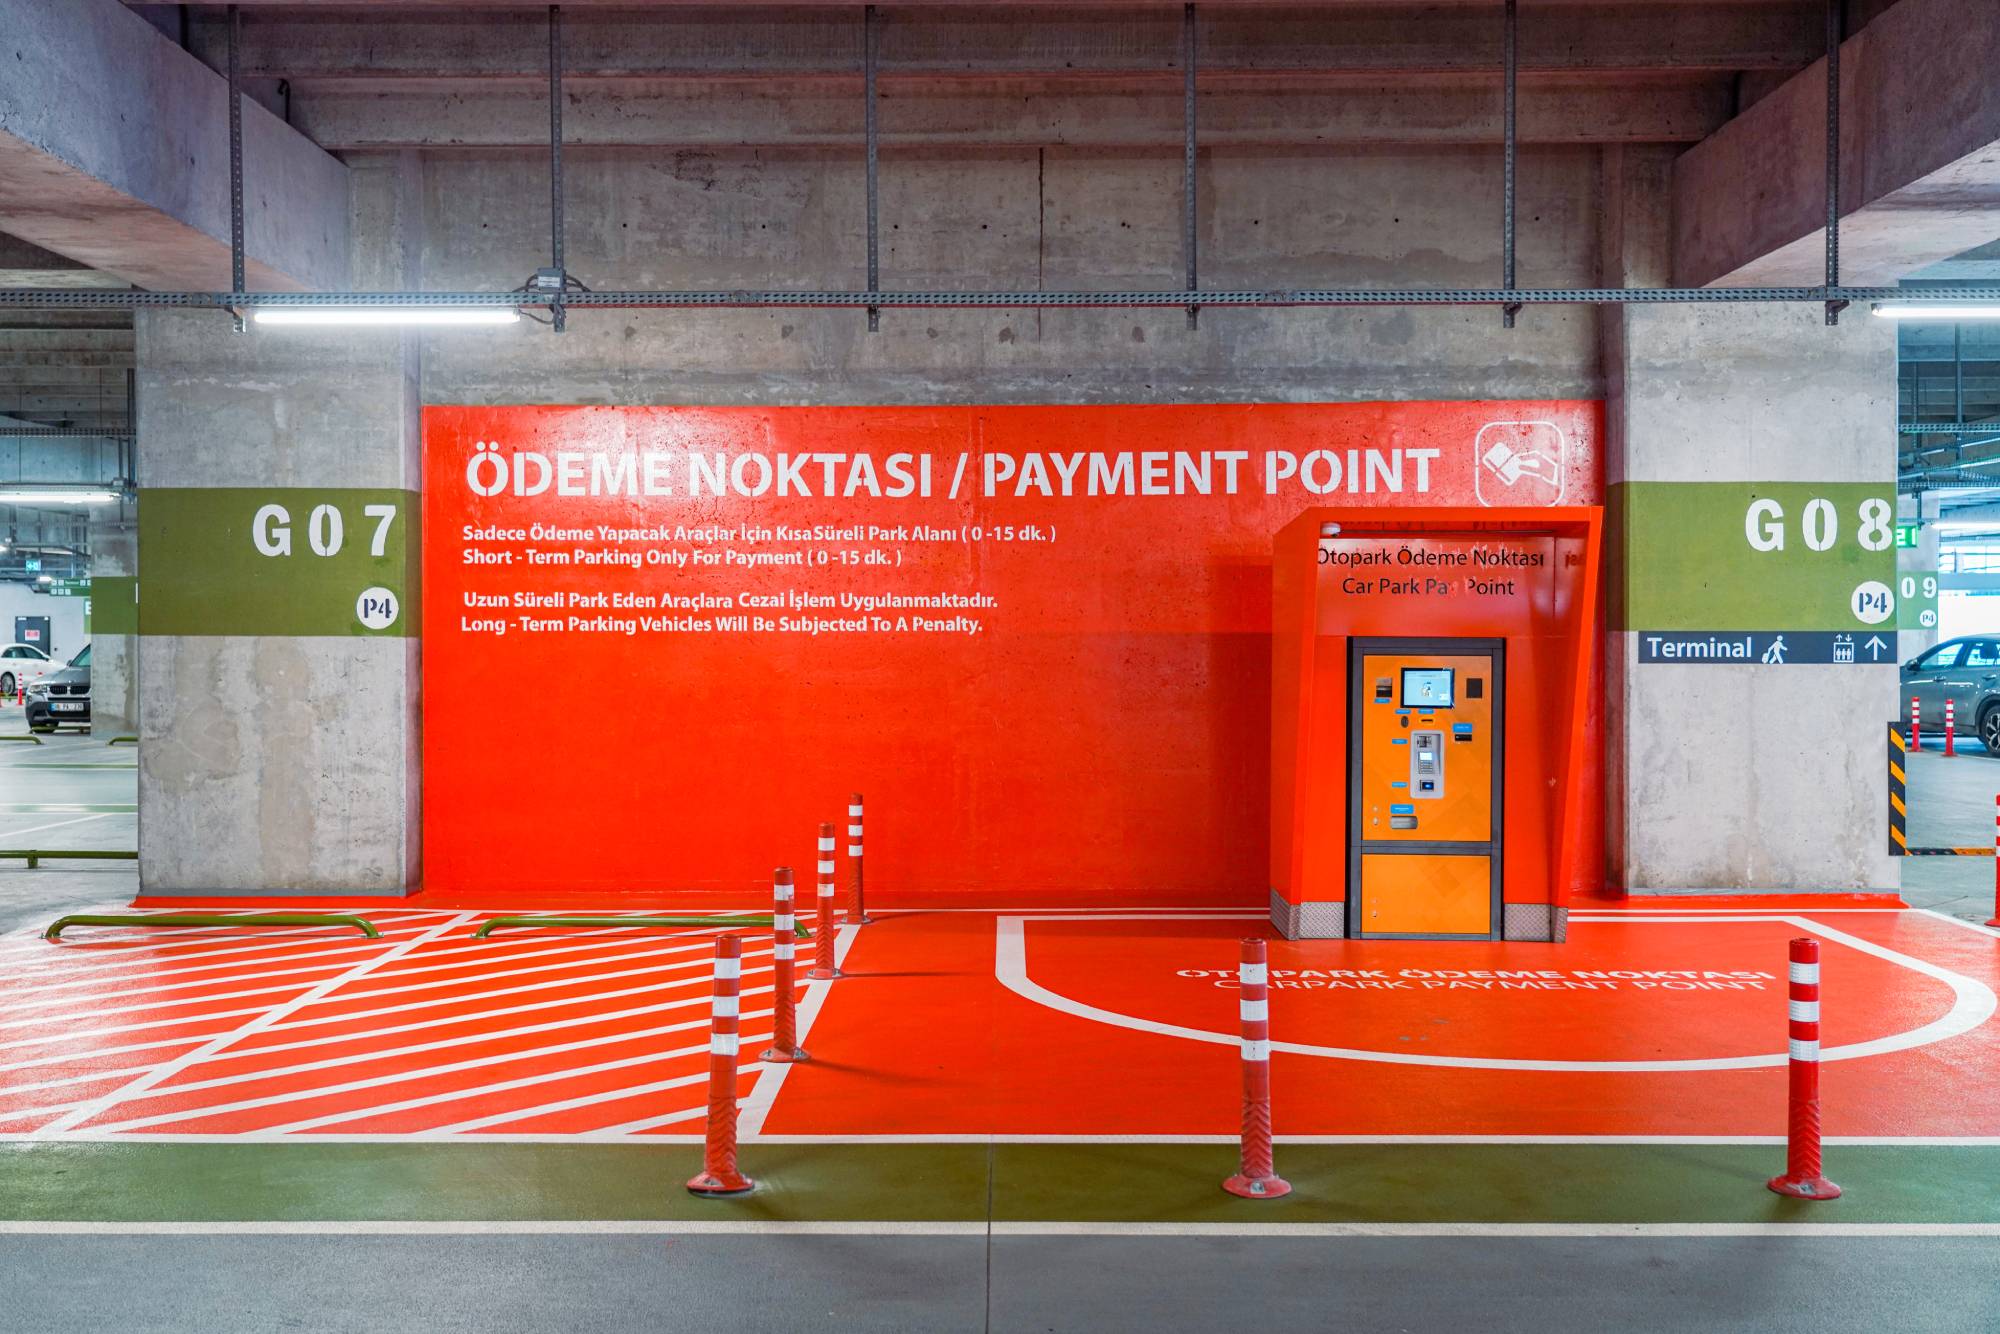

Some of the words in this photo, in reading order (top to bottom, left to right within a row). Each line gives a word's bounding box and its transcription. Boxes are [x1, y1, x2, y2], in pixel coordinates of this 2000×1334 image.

[466, 442, 673, 498] ÖDEME
[689, 452, 931, 498] NOKTASI
[948, 453, 968, 499] /
[984, 451, 1248, 497] PAYMENT
[1265, 448, 1440, 495] POINT
[463, 526, 526, 541] Sadece
[529, 523, 594, 541] Ödeme
[597, 526, 671, 544] Yapacak
[673, 526, 737, 545] Araçlar
[741, 523, 772, 545] İçin
[868, 526, 908, 541] Park
[912, 526, 957, 541] Alanı
[1018, 526, 1047, 541] dk.
[463, 549, 513, 564] Short
[526, 549, 570, 564] Term
[574, 549, 642, 568] Parking
[646, 549, 689, 567] Only
[693, 550, 722, 564] For
[725, 550, 803, 568] Payment
[864, 549, 892, 565] dk.
[1318, 547, 1392, 568] Otopark
[1396, 545, 1468, 566] Ödeme
[1473, 548, 1545, 567] Noktası
[1342, 578, 1374, 594] Car
[1380, 578, 1420, 594] Park
[362, 597, 393, 619] P4
[464, 592, 509, 607] Uzun
[514, 591, 564, 608] Süreli
[569, 592, 609, 608] Park
[613, 593, 656, 608] Eden
[660, 593, 733, 611] Araçlara
[738, 592, 785, 608] Cezai
[789, 589, 836, 611] İşlem
[840, 592, 998, 611] Uygulanmaktadır.
[1858, 591, 1888, 614] P4
[461, 617, 507, 635] Long
[519, 617, 564, 632] Term
[568, 617, 636, 635] Parking
[639, 616, 712, 632] Vehicles
[715, 616, 748, 632] Will
[753, 617, 775, 632] Be
[779, 616, 868, 636] Subjected
[870, 617, 891, 632] To
[895, 618, 908, 631] A
[912, 616, 983, 635] Penalty.
[1646, 636, 1752, 658] Terminal
[1176, 969, 1391, 979] OTPARK
[1398, 968, 1567, 979] ÖDEME
[1571, 970, 1777, 980] NOKTASI
[1421, 980, 1619, 990] PAYMENT
[1632, 980, 1768, 990] POINT
